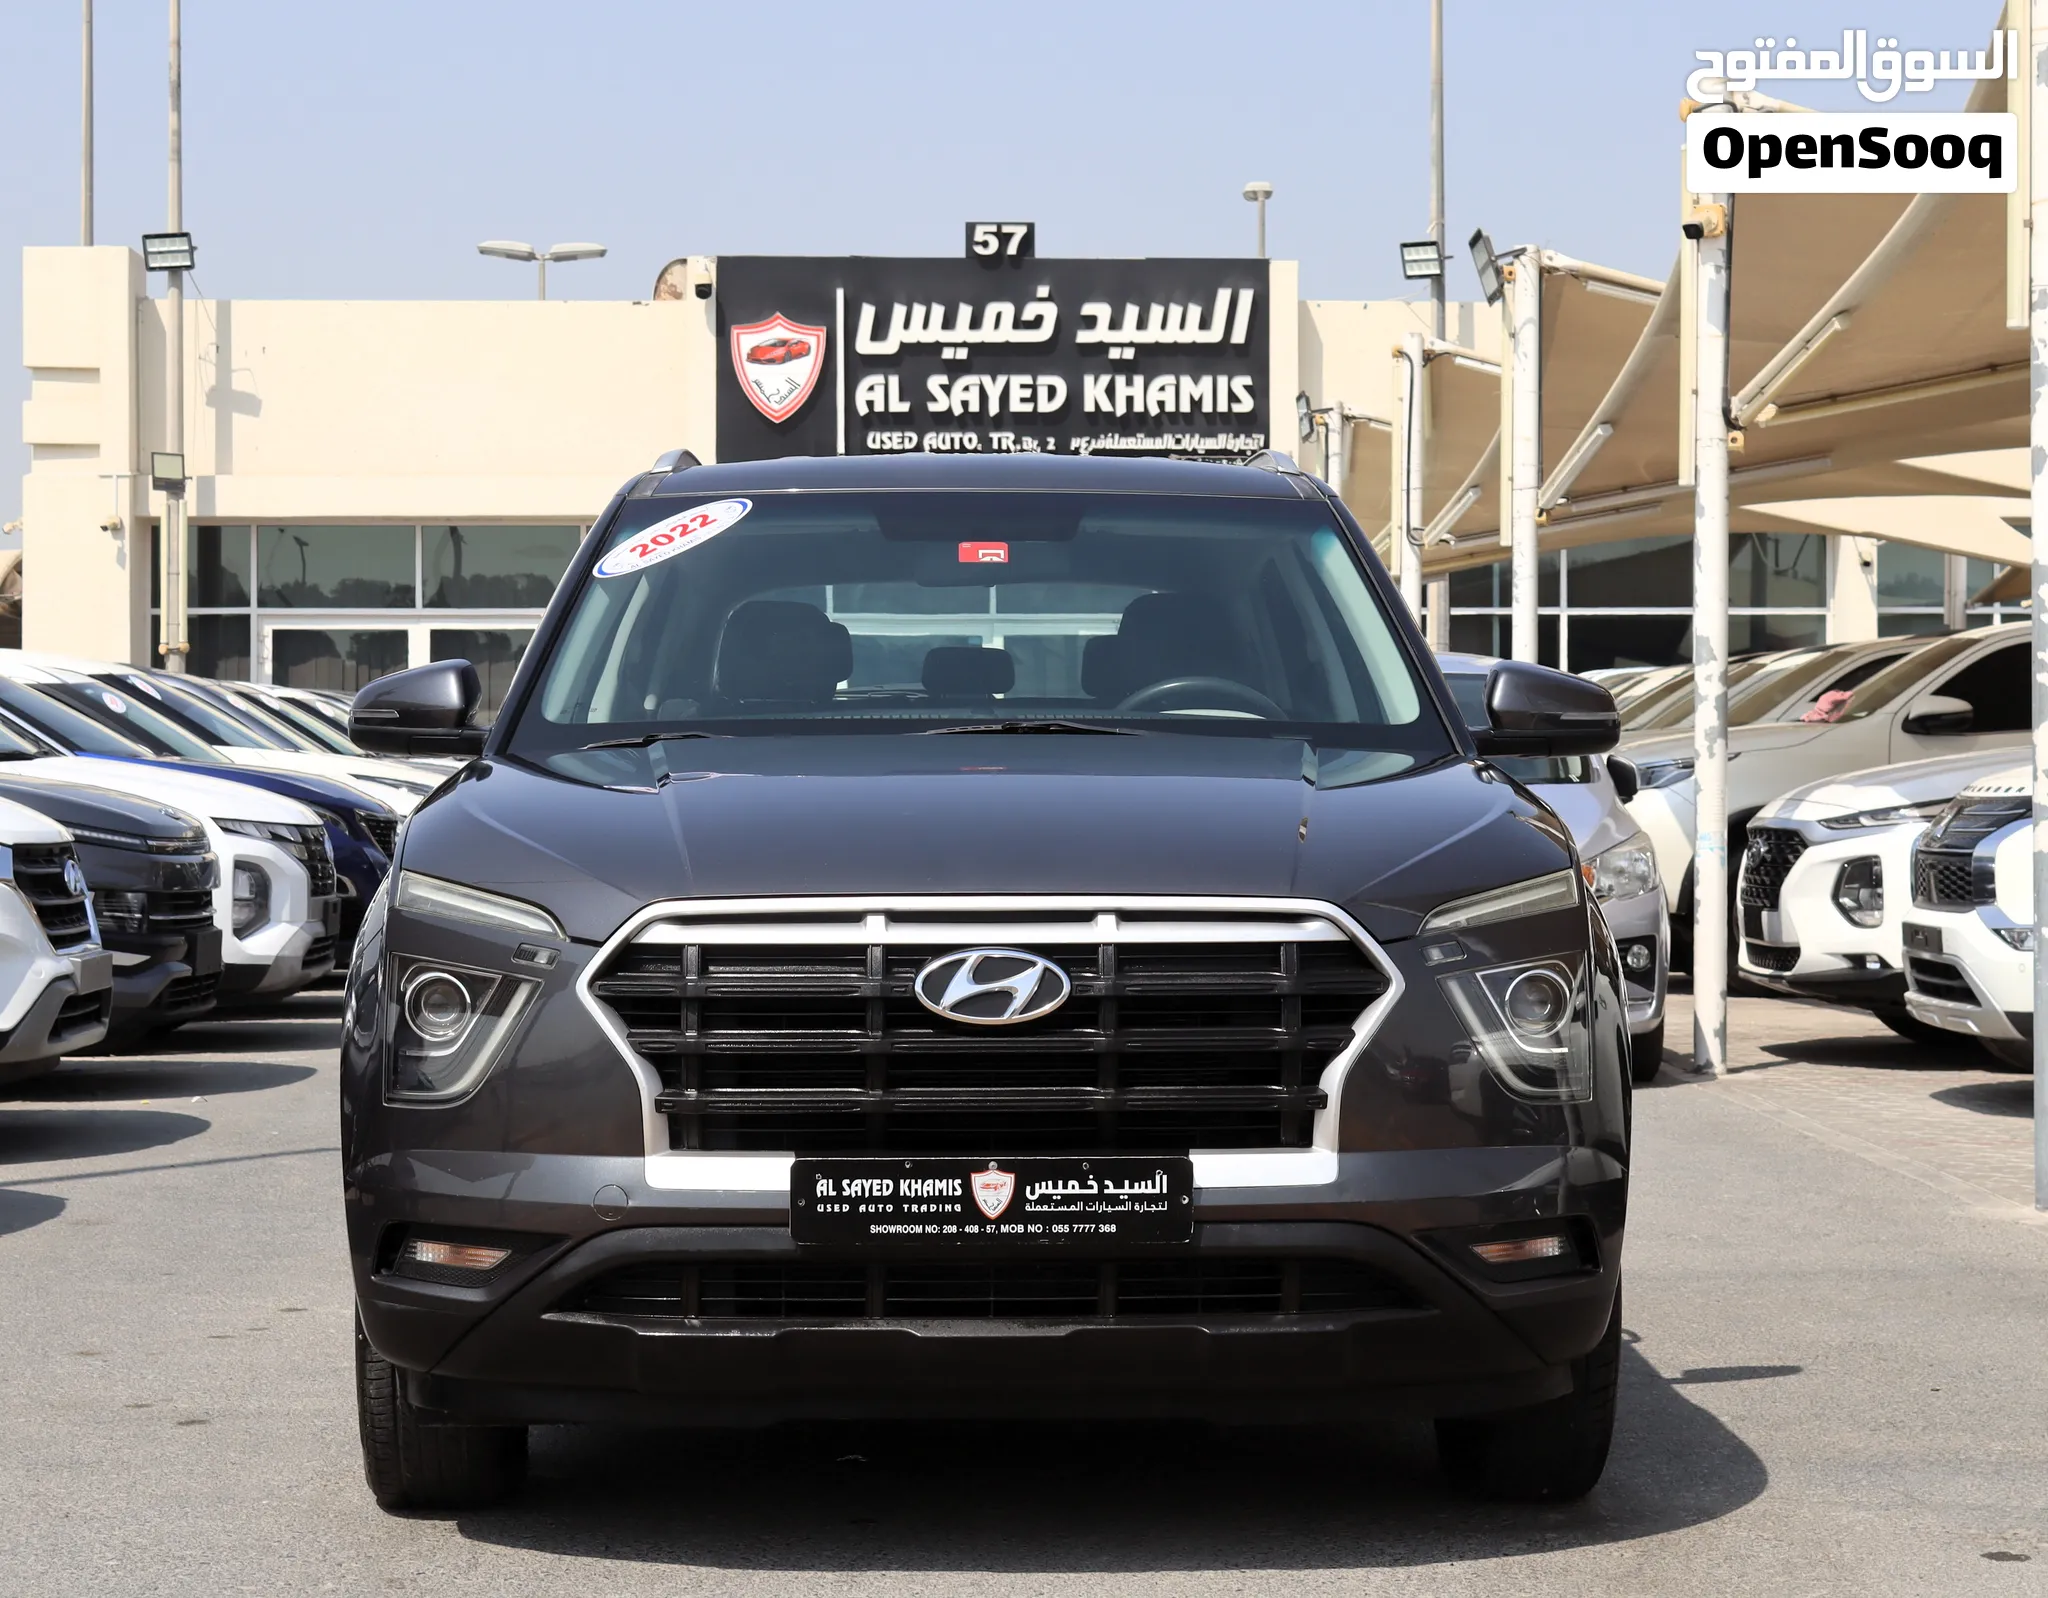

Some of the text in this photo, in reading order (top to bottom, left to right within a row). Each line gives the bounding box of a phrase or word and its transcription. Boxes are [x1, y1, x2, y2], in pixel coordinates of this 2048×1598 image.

[972, 224, 1028, 256] 57
[854, 284, 1255, 360] السيد خميس
[854, 373, 1255, 418] AL SAYED KHAMIS
[866, 431, 919, 450] USED
[629, 513, 718, 558] 2022
[816, 1178, 963, 1199] AL SAYED KHAMIS
[1025, 1174, 1168, 1201] السيد خميس
[816, 1203, 962, 1213] USED AUTO TRADING
[1024, 1200, 1168, 1214] لتجارة السيارات المستعملة
[869, 1224, 923, 1234] SHOWROOM
[924, 1224, 941, 1234] NO:
[942, 1224, 957, 1234] 208
[964, 1224, 979, 1234] 408
[1000, 1224, 1024, 1233] MOB
[1027, 1224, 1043, 1233] NO
[1051, 1224, 1070, 1233] 055
[1072, 1224, 1096, 1233] 7777
[1098, 1224, 1117, 1233] 368
